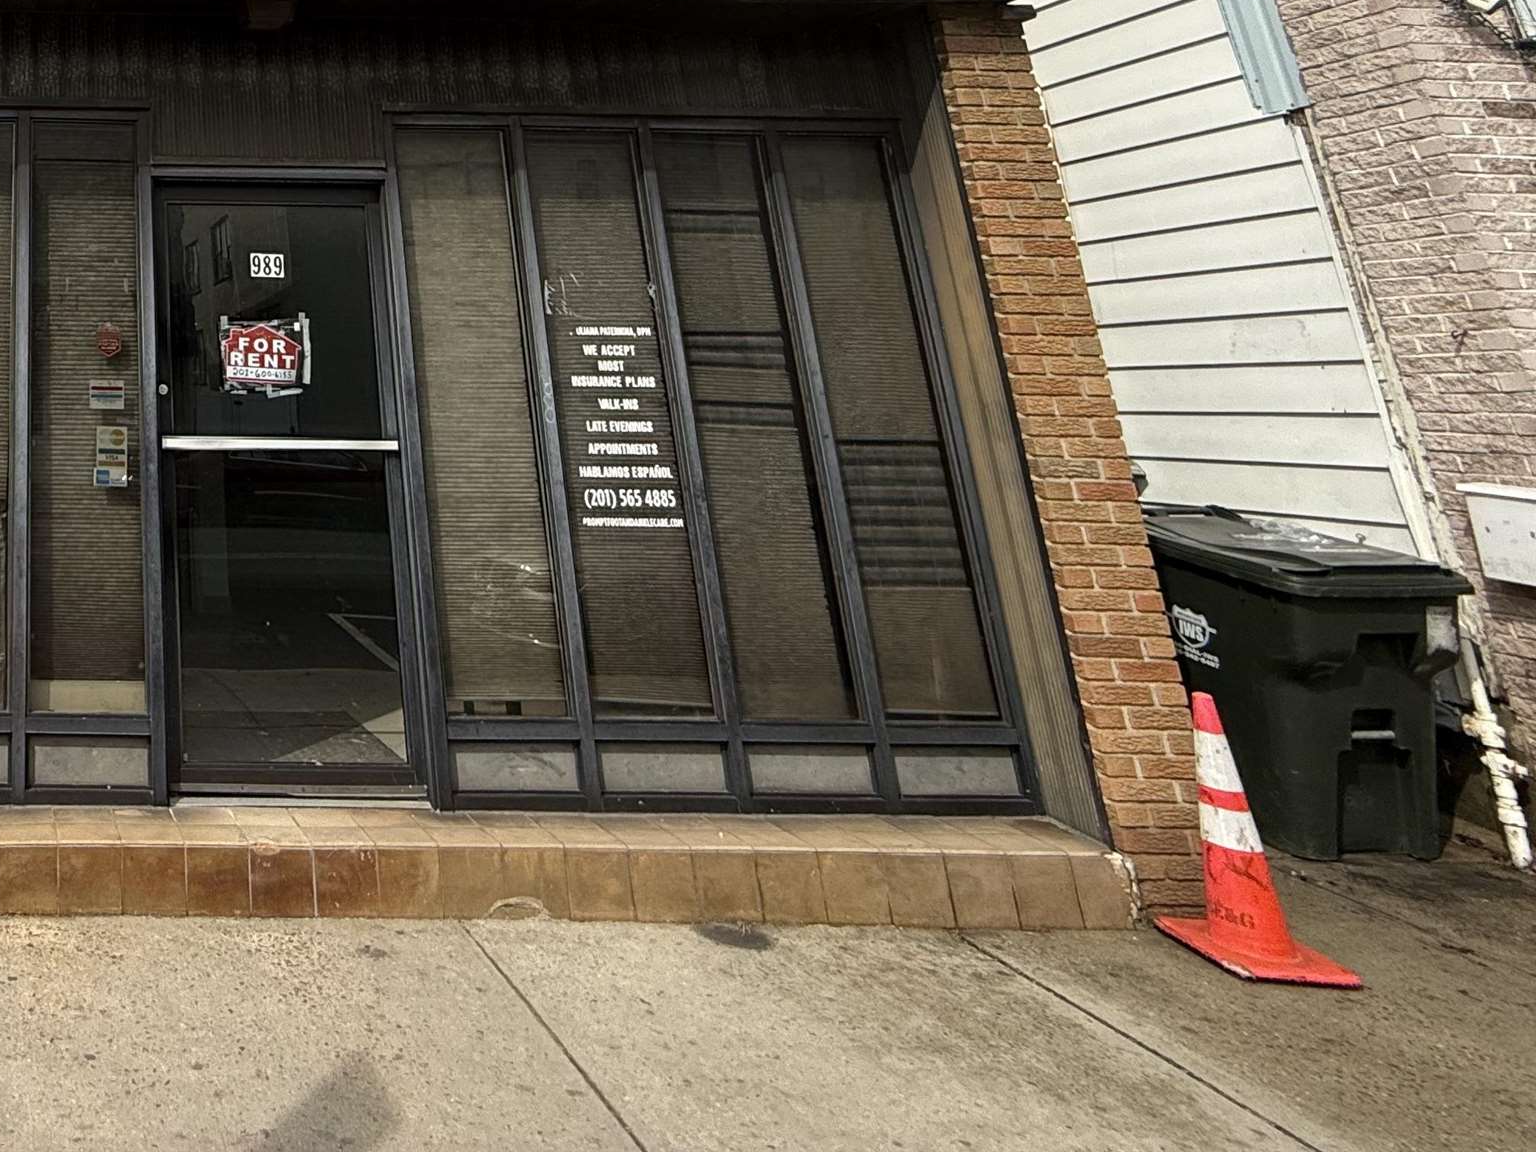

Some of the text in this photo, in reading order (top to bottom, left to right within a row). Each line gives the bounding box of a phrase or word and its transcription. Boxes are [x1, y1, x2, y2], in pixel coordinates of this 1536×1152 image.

[252, 254, 283, 277] 989
[238, 336, 286, 354] FOR
[582, 344, 635, 356] WE ACCEPT
[230, 351, 295, 369] RENT
[597, 360, 624, 372] MOST
[571, 375, 656, 388] INSURANCE PLANS
[586, 420, 653, 432] LATE EVENINGS
[588, 442, 658, 455] APPOINTMENTS
[579, 464, 673, 479] HABLAMOS ESPAÑOL
[584, 488, 676, 509] (201) 565 4885
[1178, 619, 1204, 641] IWS
